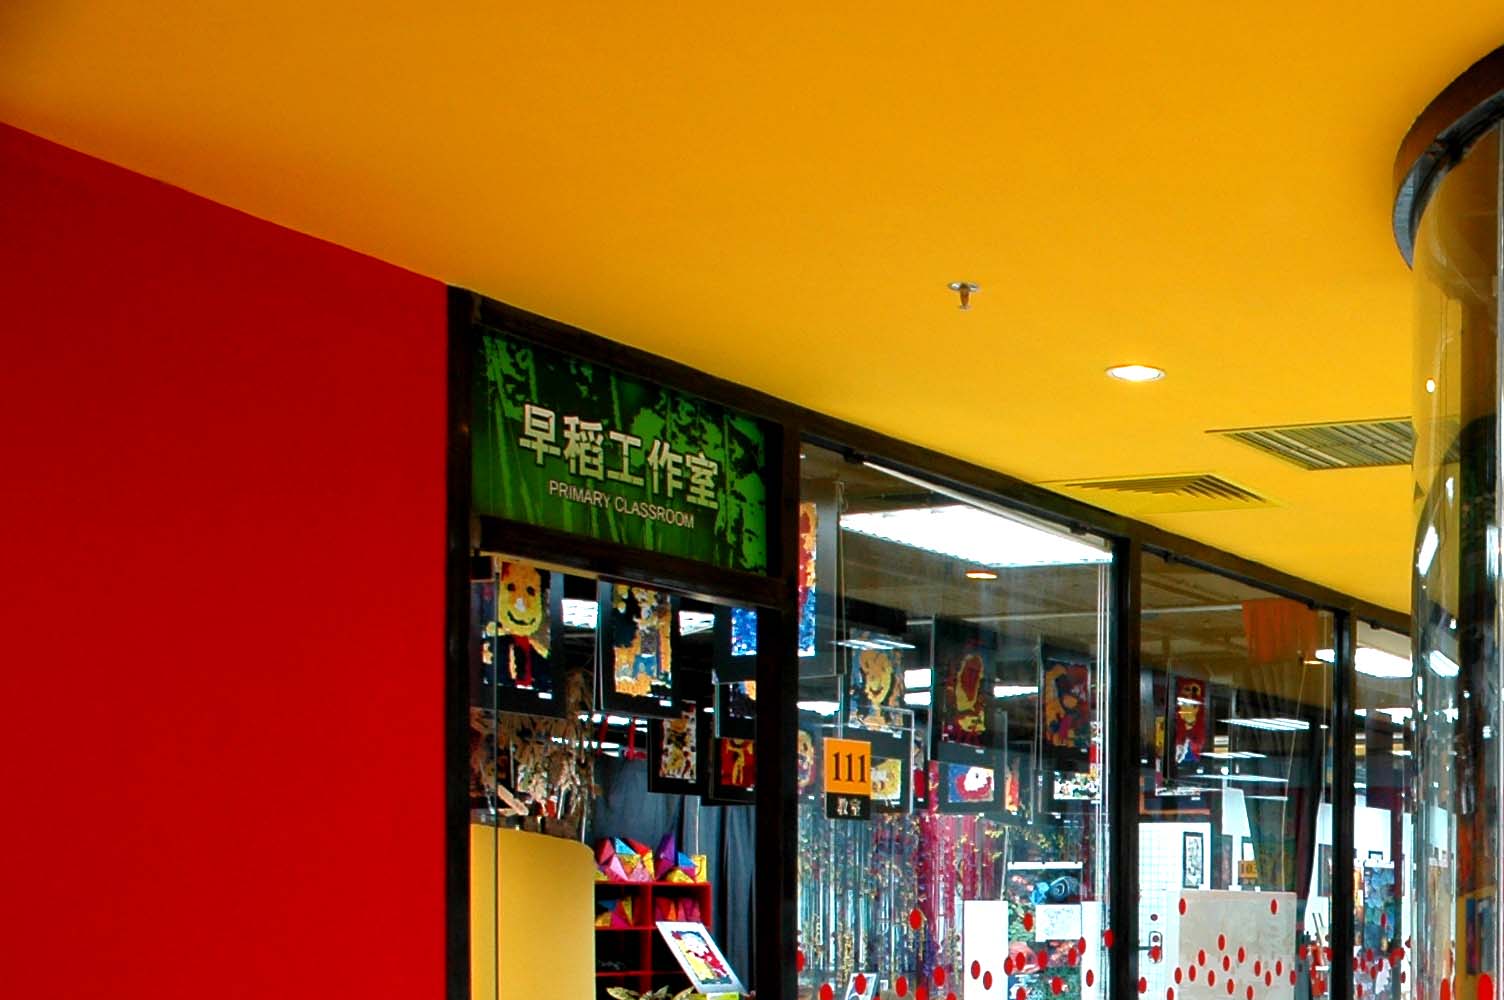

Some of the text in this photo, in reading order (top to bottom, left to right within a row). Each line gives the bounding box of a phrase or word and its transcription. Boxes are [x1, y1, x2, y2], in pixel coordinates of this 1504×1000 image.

[518, 402, 720, 511] 早稻工作室
[549, 479, 695, 529] PRIMARY CLASSROOM
[833, 751, 867, 783] 111
